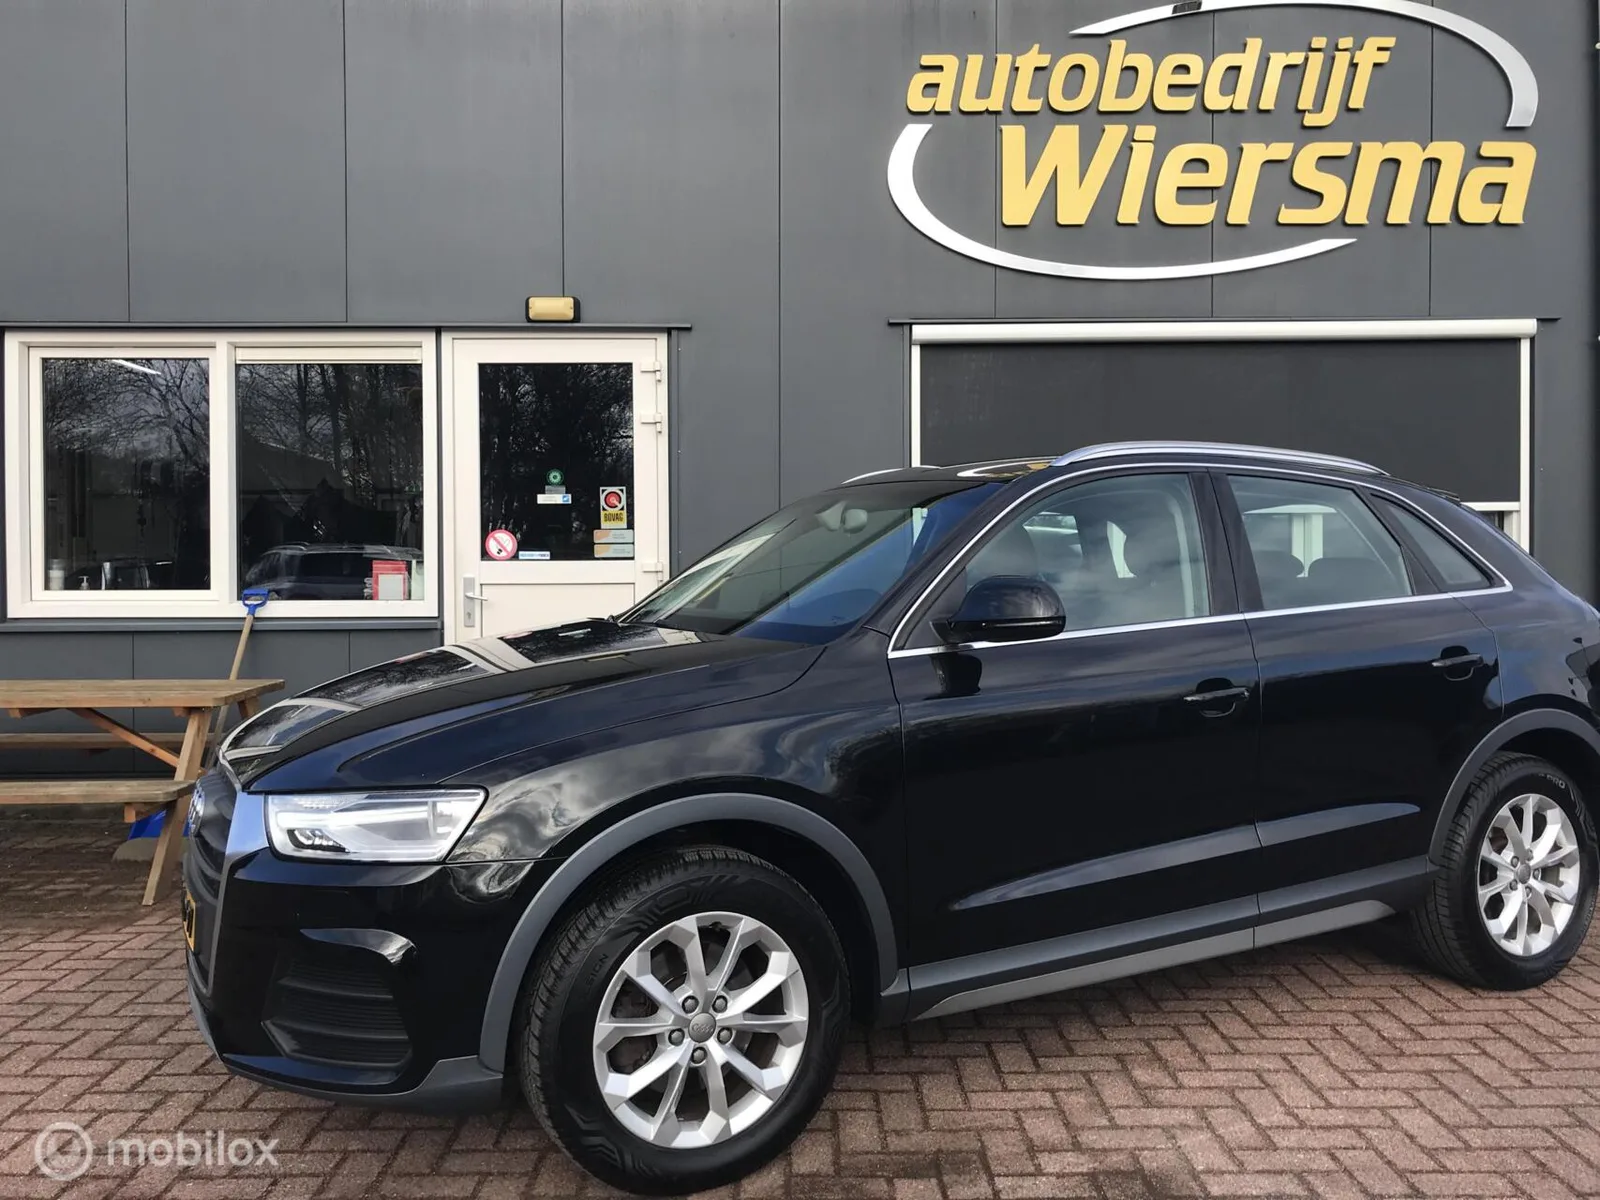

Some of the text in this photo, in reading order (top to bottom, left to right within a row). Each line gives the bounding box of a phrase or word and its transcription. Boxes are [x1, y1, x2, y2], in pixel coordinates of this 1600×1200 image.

[906, 36, 1397, 128] autobedrijf
[1000, 124, 1538, 226] Wiersma
[603, 512, 624, 523] BOVAG
